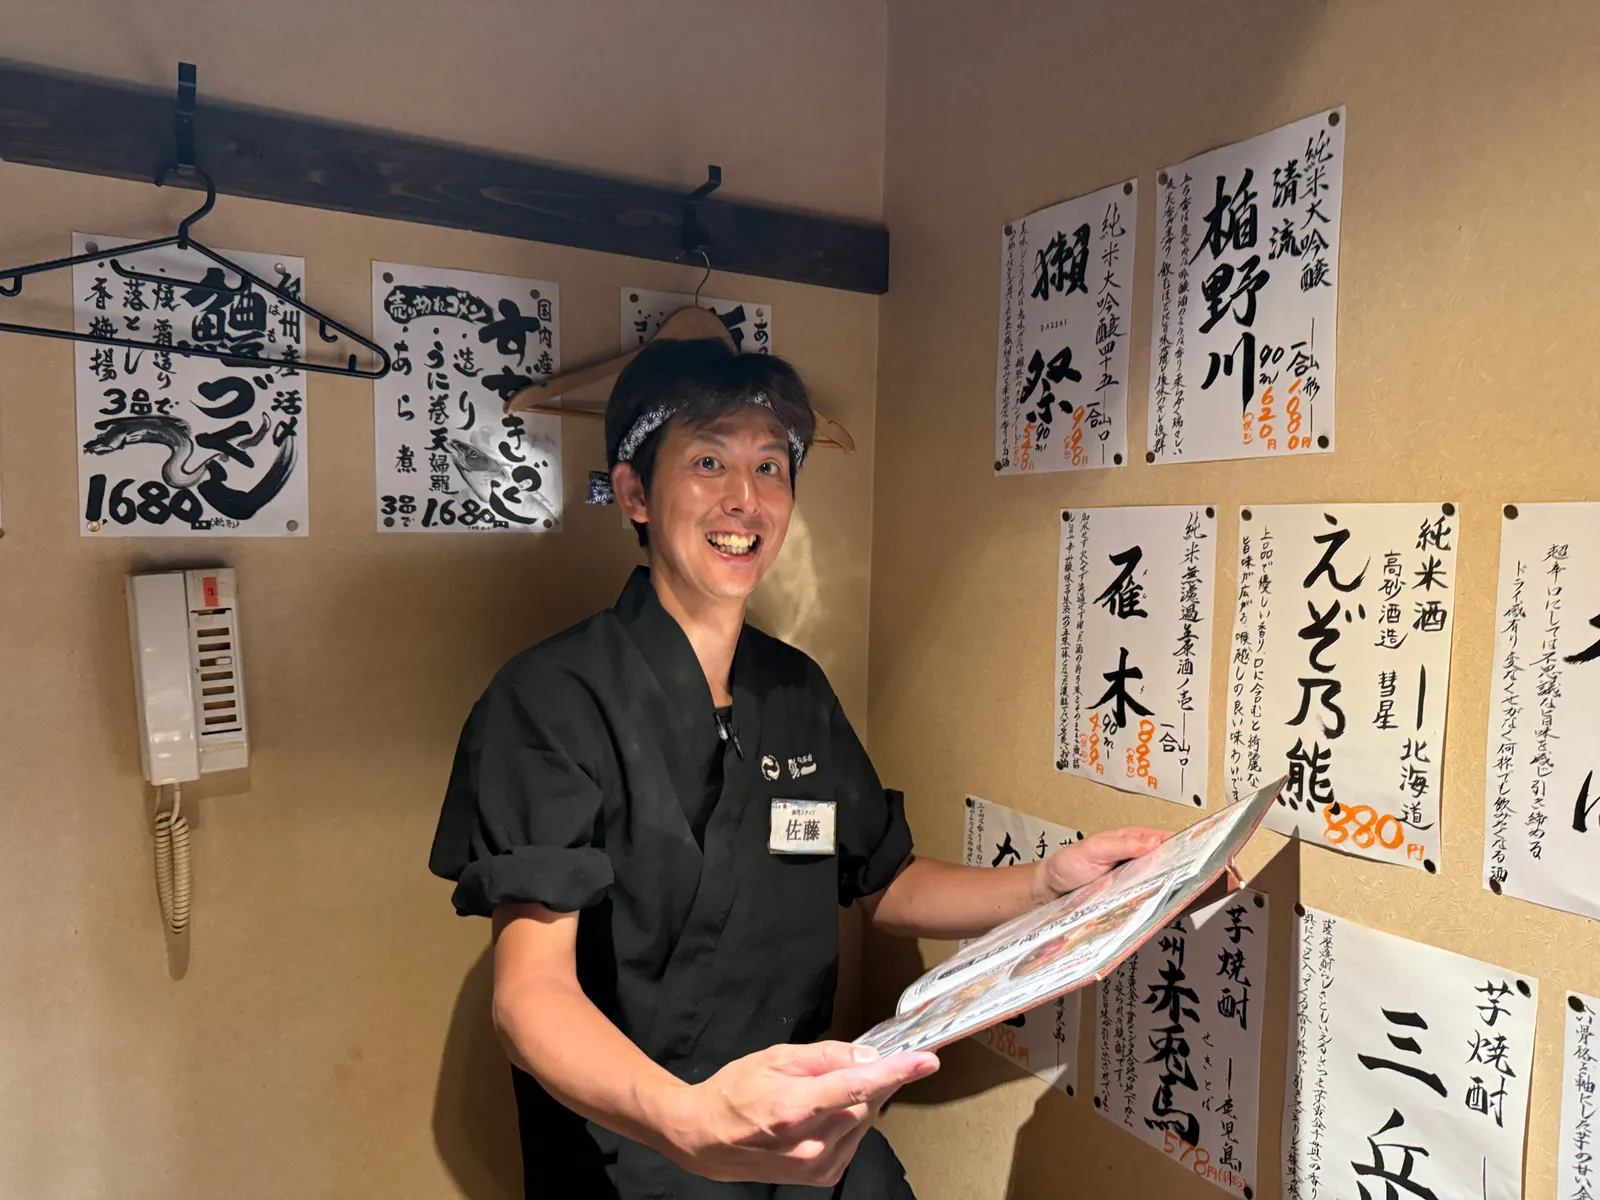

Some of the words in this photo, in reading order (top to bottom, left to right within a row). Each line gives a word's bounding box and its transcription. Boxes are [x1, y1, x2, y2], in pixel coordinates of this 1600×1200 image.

[1268, 159, 1302, 261] 清流
[388, 289, 488, 322] 売り切れゴメン
[1020, 223, 1090, 424] 獺祭
[1040, 318, 1068, 332] DASSAI
[1189, 168, 1271, 415] 楯野川
[1411, 515, 1452, 633] 純米酒
[1086, 544, 1156, 729] 雁木
[1276, 512, 1371, 816] えぞ乃熊
[786, 819, 820, 841] 佐藤
[1322, 803, 1425, 861] 880円
[1216, 903, 1254, 1032] 芋焼酎
[1464, 979, 1517, 1128] 芋焼酎
